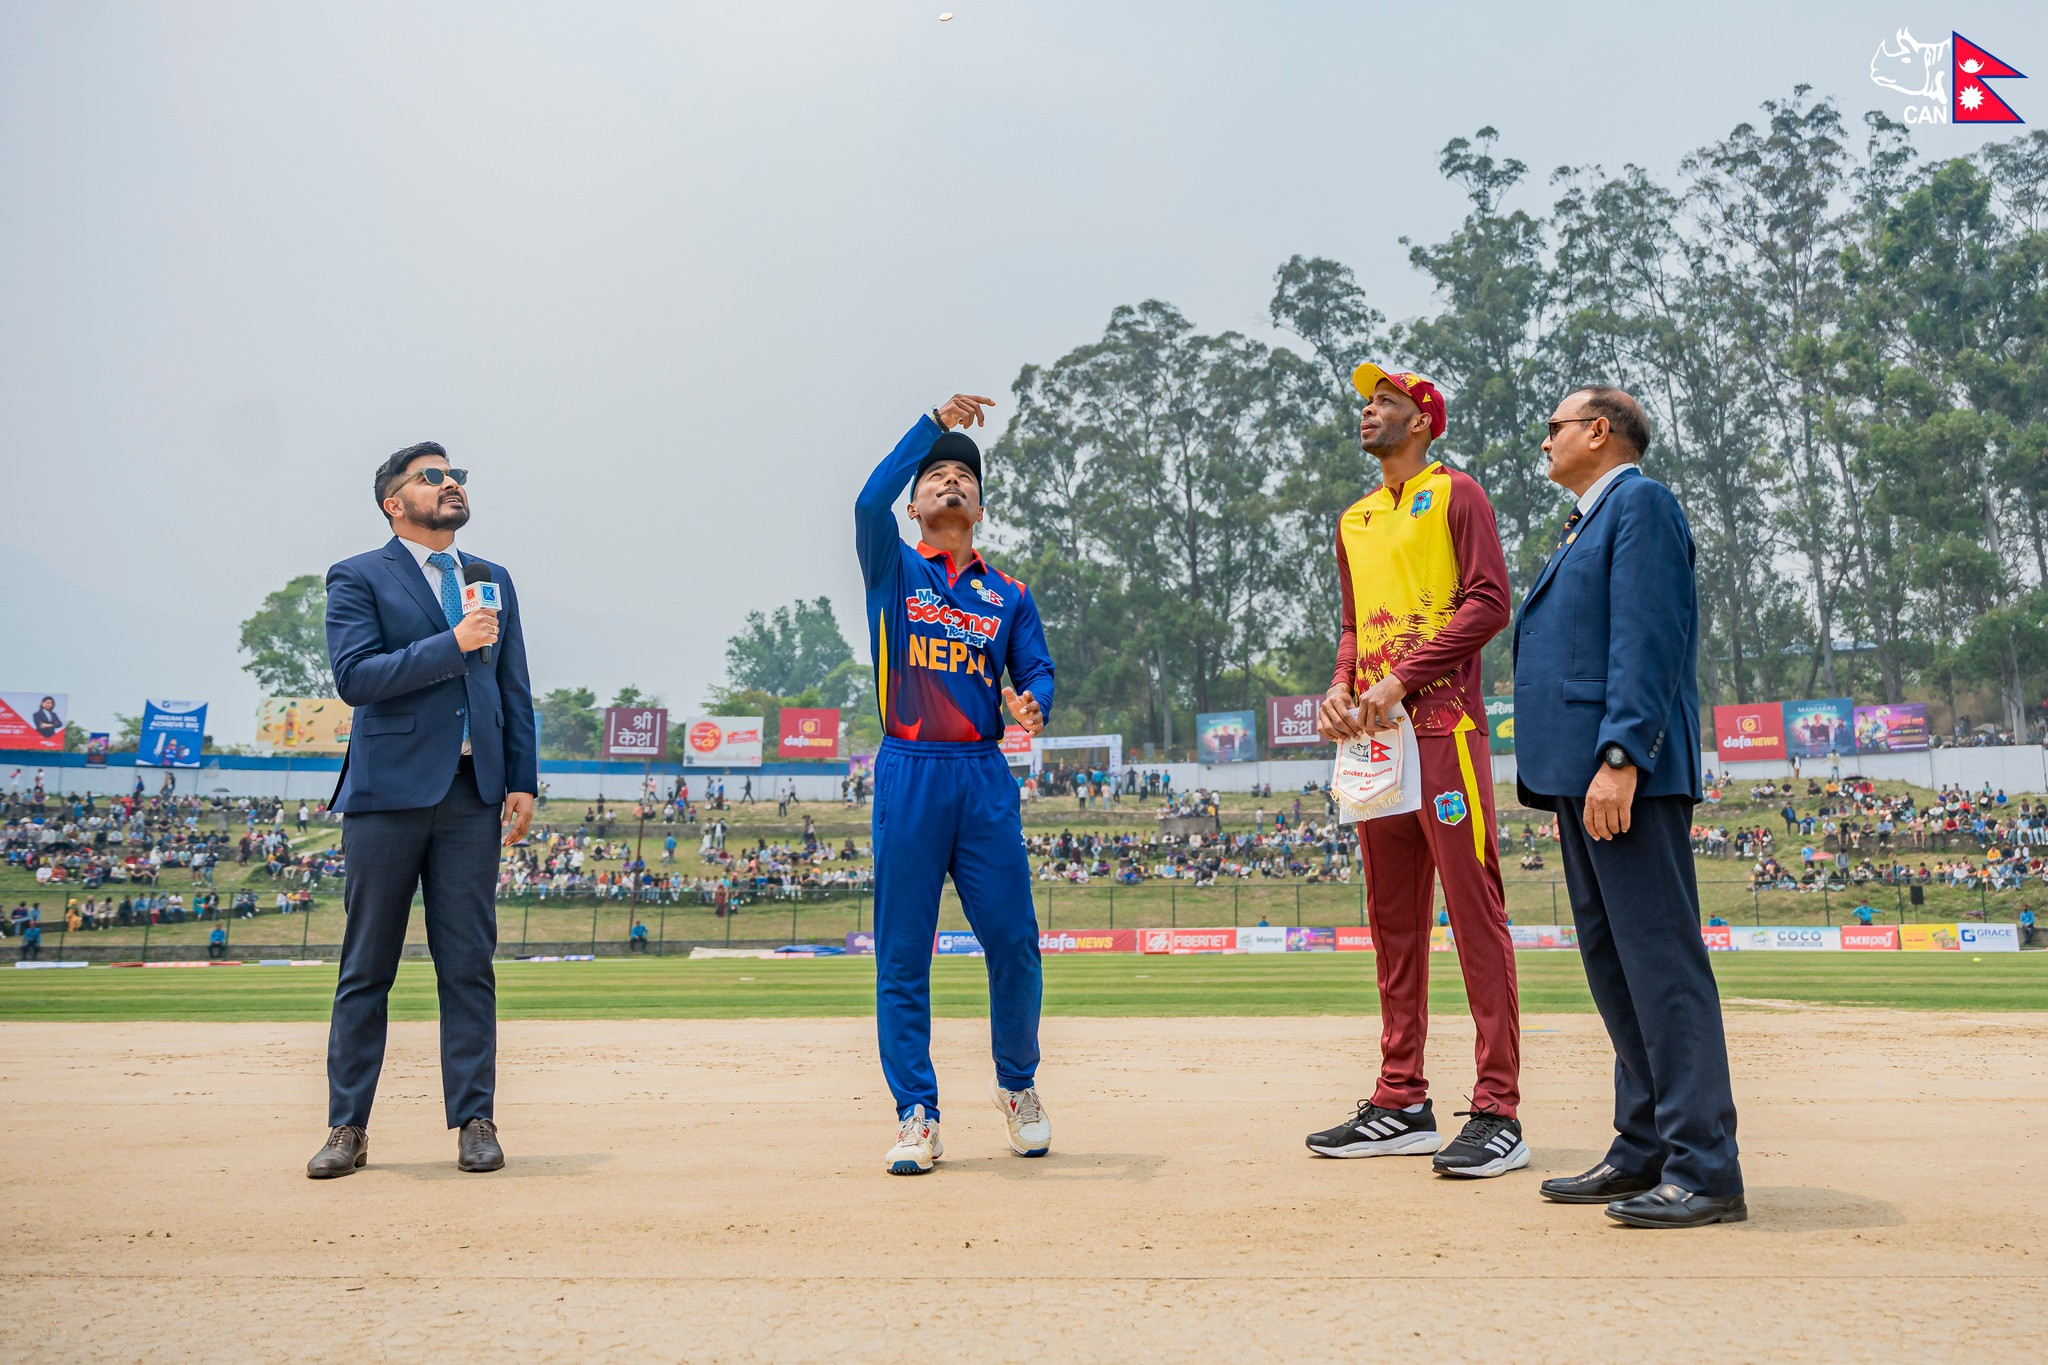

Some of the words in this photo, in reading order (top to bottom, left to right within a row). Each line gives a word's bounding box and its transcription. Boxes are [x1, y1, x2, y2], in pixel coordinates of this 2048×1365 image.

[917, 589, 940, 606] My
[906, 597, 1001, 640] Second
[947, 625, 986, 647] Teher
[1293, 699, 1313, 718] श्री
[632, 711, 654, 730] श्री
[1280, 717, 1313, 735] केश
[617, 727, 653, 747] केश
[1174, 934, 1229, 948] FIBERNET
[1777, 930, 1822, 941] COCO
[1976, 928, 2013, 937] GRACE
